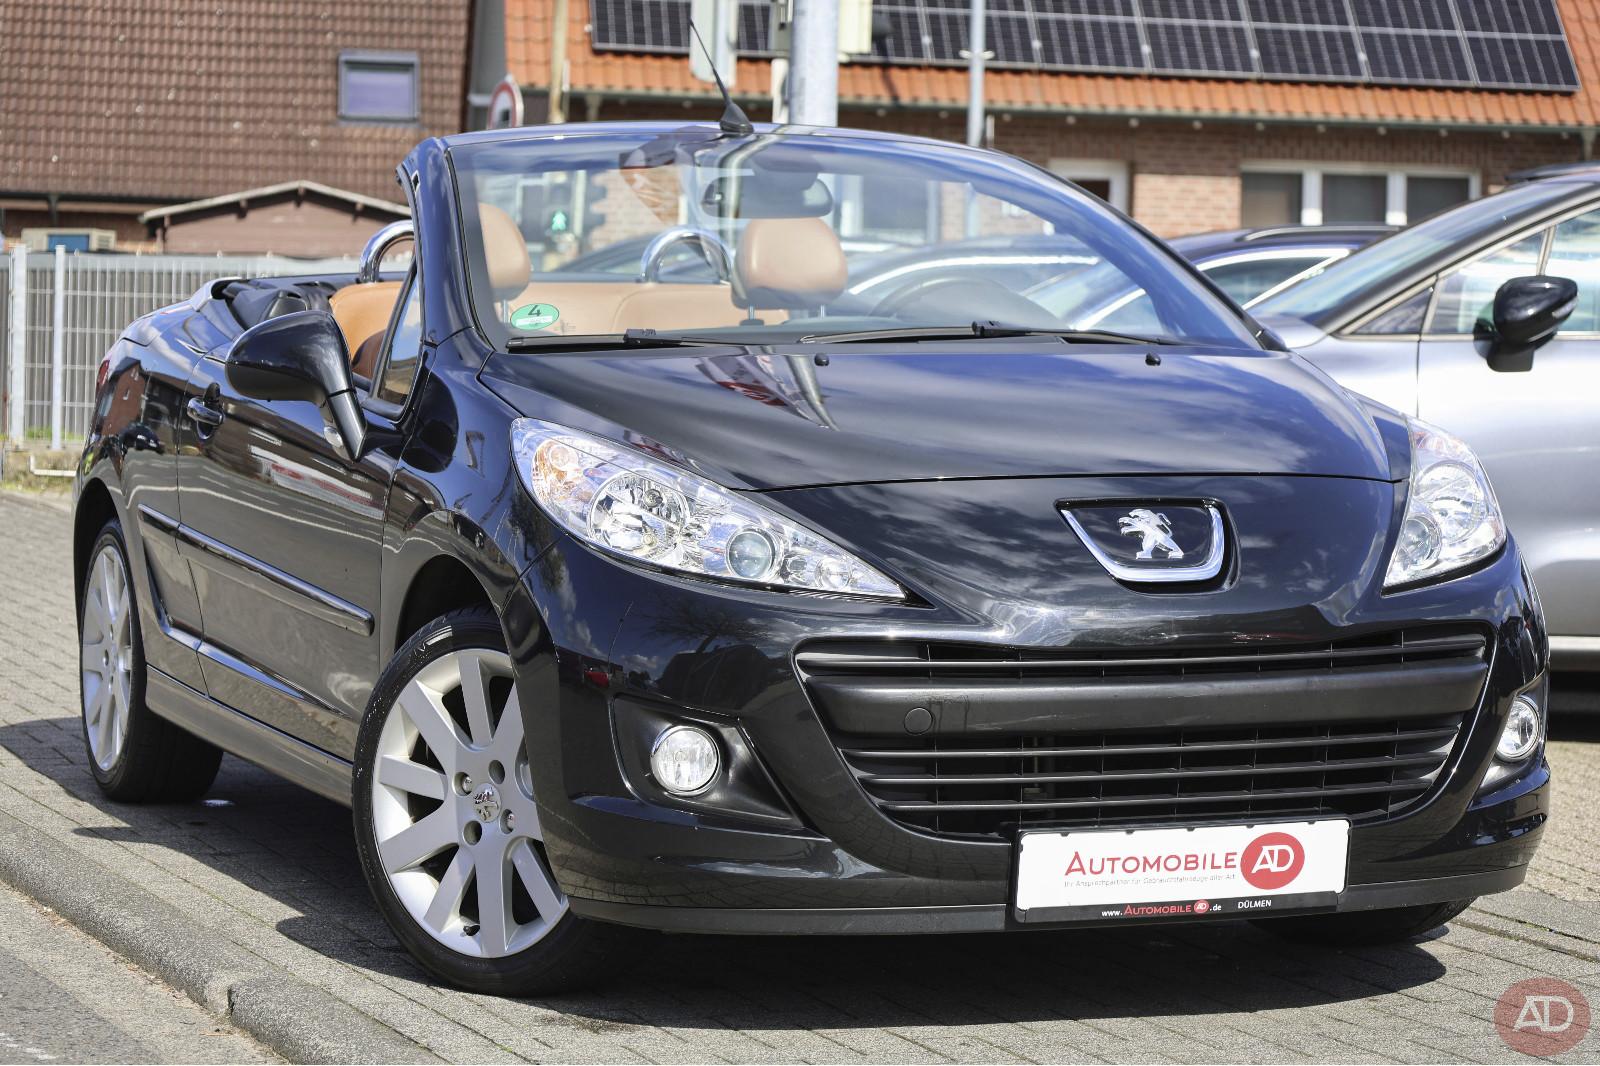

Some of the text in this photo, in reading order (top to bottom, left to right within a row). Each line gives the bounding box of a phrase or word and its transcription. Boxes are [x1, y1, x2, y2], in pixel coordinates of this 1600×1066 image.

[528, 304, 542, 317] 4
[1065, 844, 1295, 875] AUTOMOBILE AD
[1238, 900, 1272, 909] DÜLMEN
